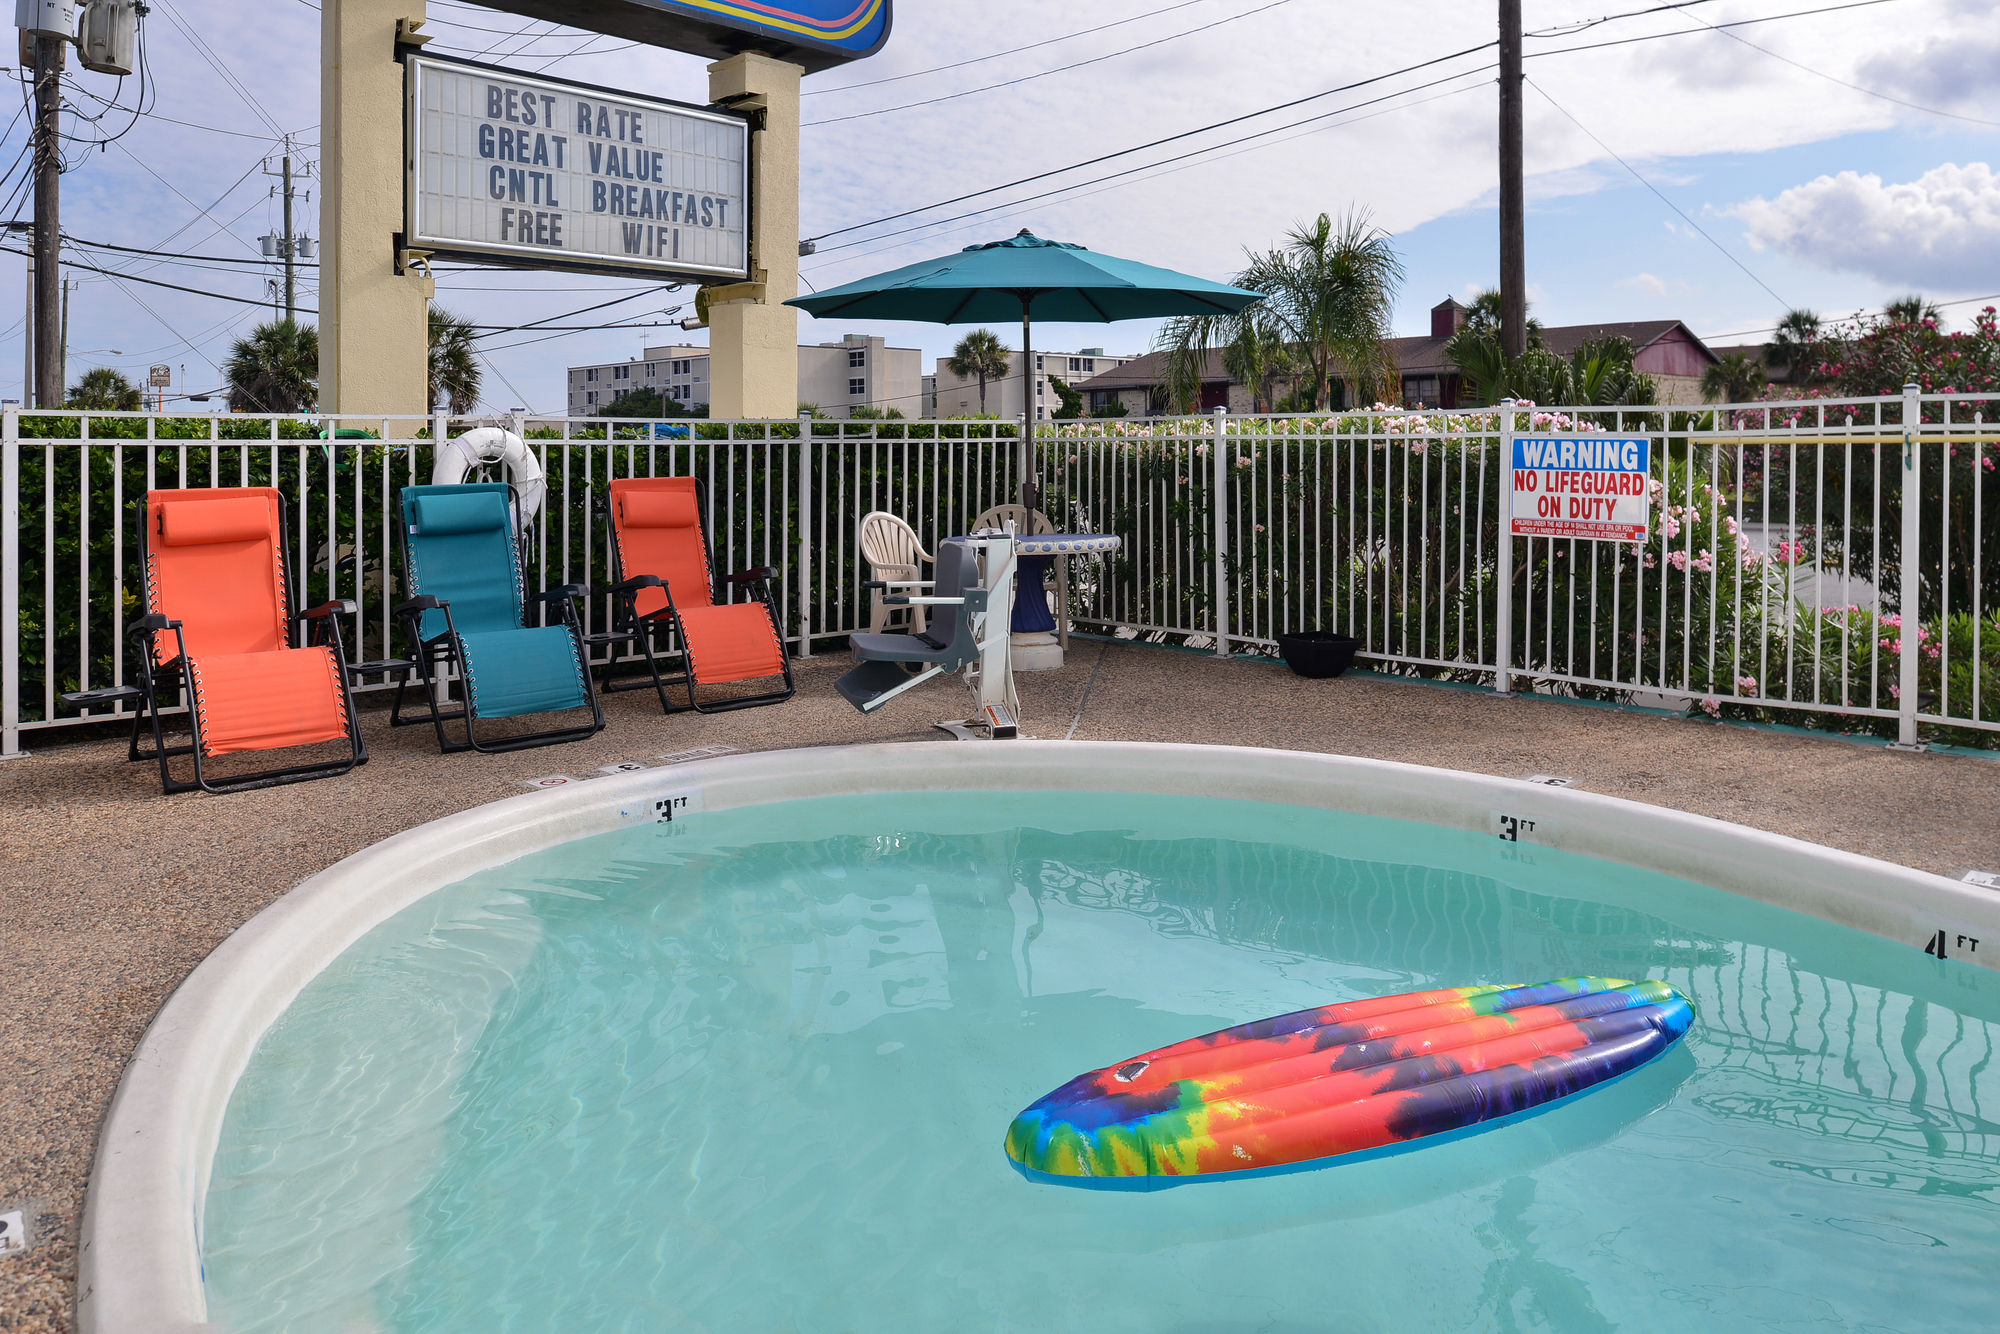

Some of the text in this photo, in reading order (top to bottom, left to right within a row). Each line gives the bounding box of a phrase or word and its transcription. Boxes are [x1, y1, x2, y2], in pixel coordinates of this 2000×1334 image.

[487, 84, 643, 144] BEST RATE
[479, 123, 663, 183] GREAT VALUE
[489, 165, 728, 228] CNTL BREAKFAST
[501, 207, 678, 259] FREE WIFI
[1522, 440, 1639, 470] WARNING
[1514, 470, 1644, 496] NO LIFEGUARD
[1537, 495, 1617, 520] ON DUTY
[656, 796, 687, 823] 3 FT
[1499, 815, 1535, 842] 3 FT
[1924, 929, 1979, 960] 4 FT
